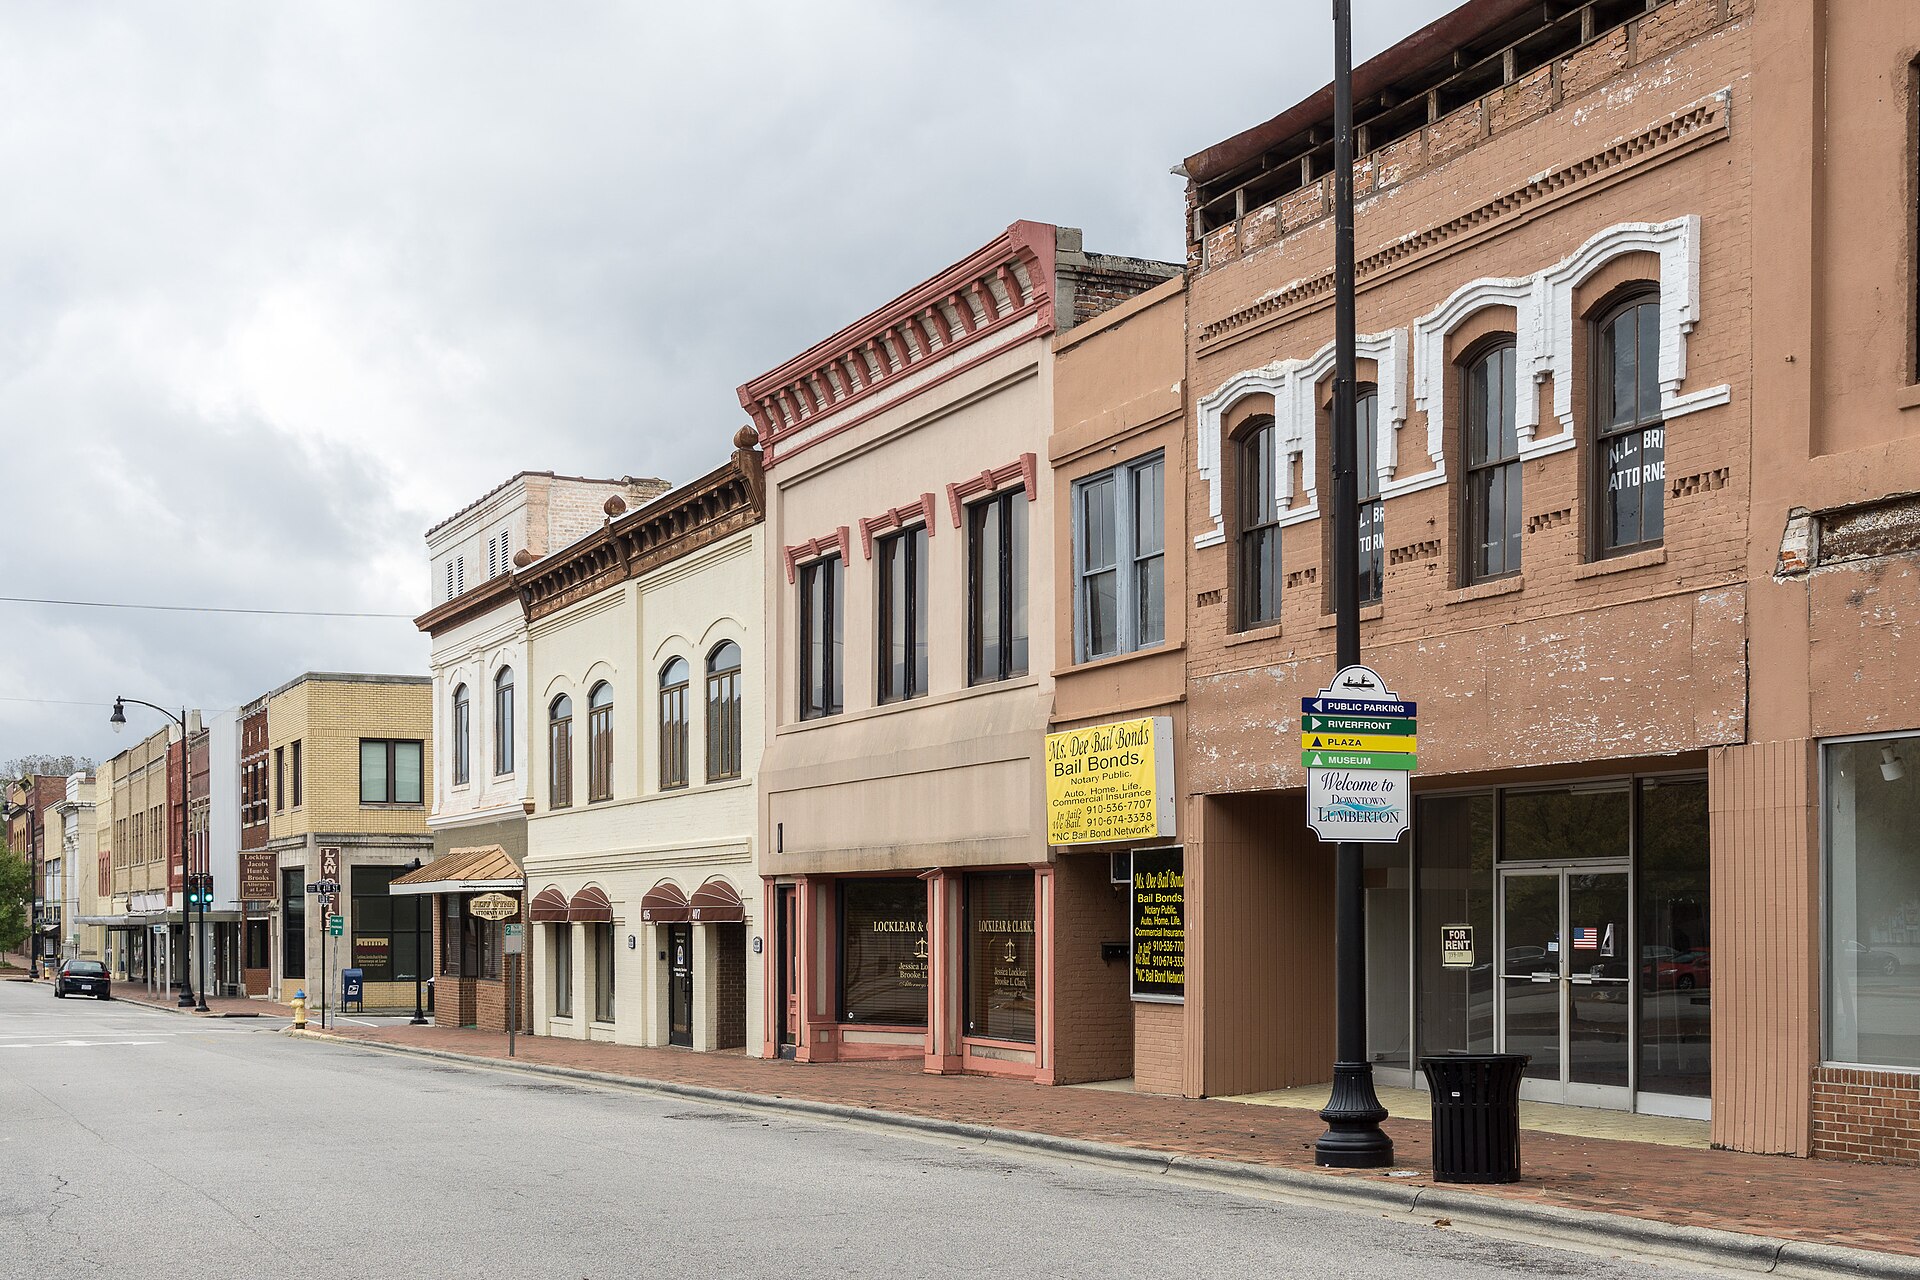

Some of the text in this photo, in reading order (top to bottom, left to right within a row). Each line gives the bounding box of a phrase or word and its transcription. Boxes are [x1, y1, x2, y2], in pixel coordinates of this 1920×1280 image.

[1644, 430, 1665, 448] BRI
[1608, 461, 1665, 491] ATTORNE
[1328, 702, 1404, 713] PUBLIC PARKING
[1328, 721, 1392, 730] RIVERFRONT
[1049, 720, 1149, 761] Ms. Dee Bail Bonds
[1328, 738, 1362, 746] PLAZA
[1054, 751, 1144, 777] Bail Bonds,
[1328, 756, 1371, 765] MUSEUM
[1071, 775, 1099, 785] Notary
[1321, 772, 1395, 792] Welcome to
[1052, 790, 1151, 807] Commercial Insurance
[1332, 794, 1386, 805] DOWNTOWN
[1086, 799, 1152, 815] 910-536-7707
[1086, 812, 1152, 827] 910-674-3338
[1318, 807, 1399, 823] LUMBERTON
[1072, 831, 1088, 840] Bail
[1090, 828, 1111, 838] Bond
[324, 849, 337, 874] LAW
[1170, 871, 1184, 888] Bond
[1137, 893, 1153, 903] Bail
[1145, 905, 1160, 916] Notary
[873, 921, 916, 932] LOCKLEAR
[918, 921, 923, 932] &
[979, 920, 1006, 932] LOCKLEAR
[1007, 921, 1012, 932] &
[1135, 927, 1184, 937] Commercial Insuranc
[1449, 930, 1466, 940] FOR
[1153, 940, 1184, 952] 910-536-770
[1445, 941, 1470, 950] RENT
[994, 968, 1027, 976] Jessica Locklear
[1155, 970, 1166, 983] Bond
[995, 977, 1009, 985] Brooke
